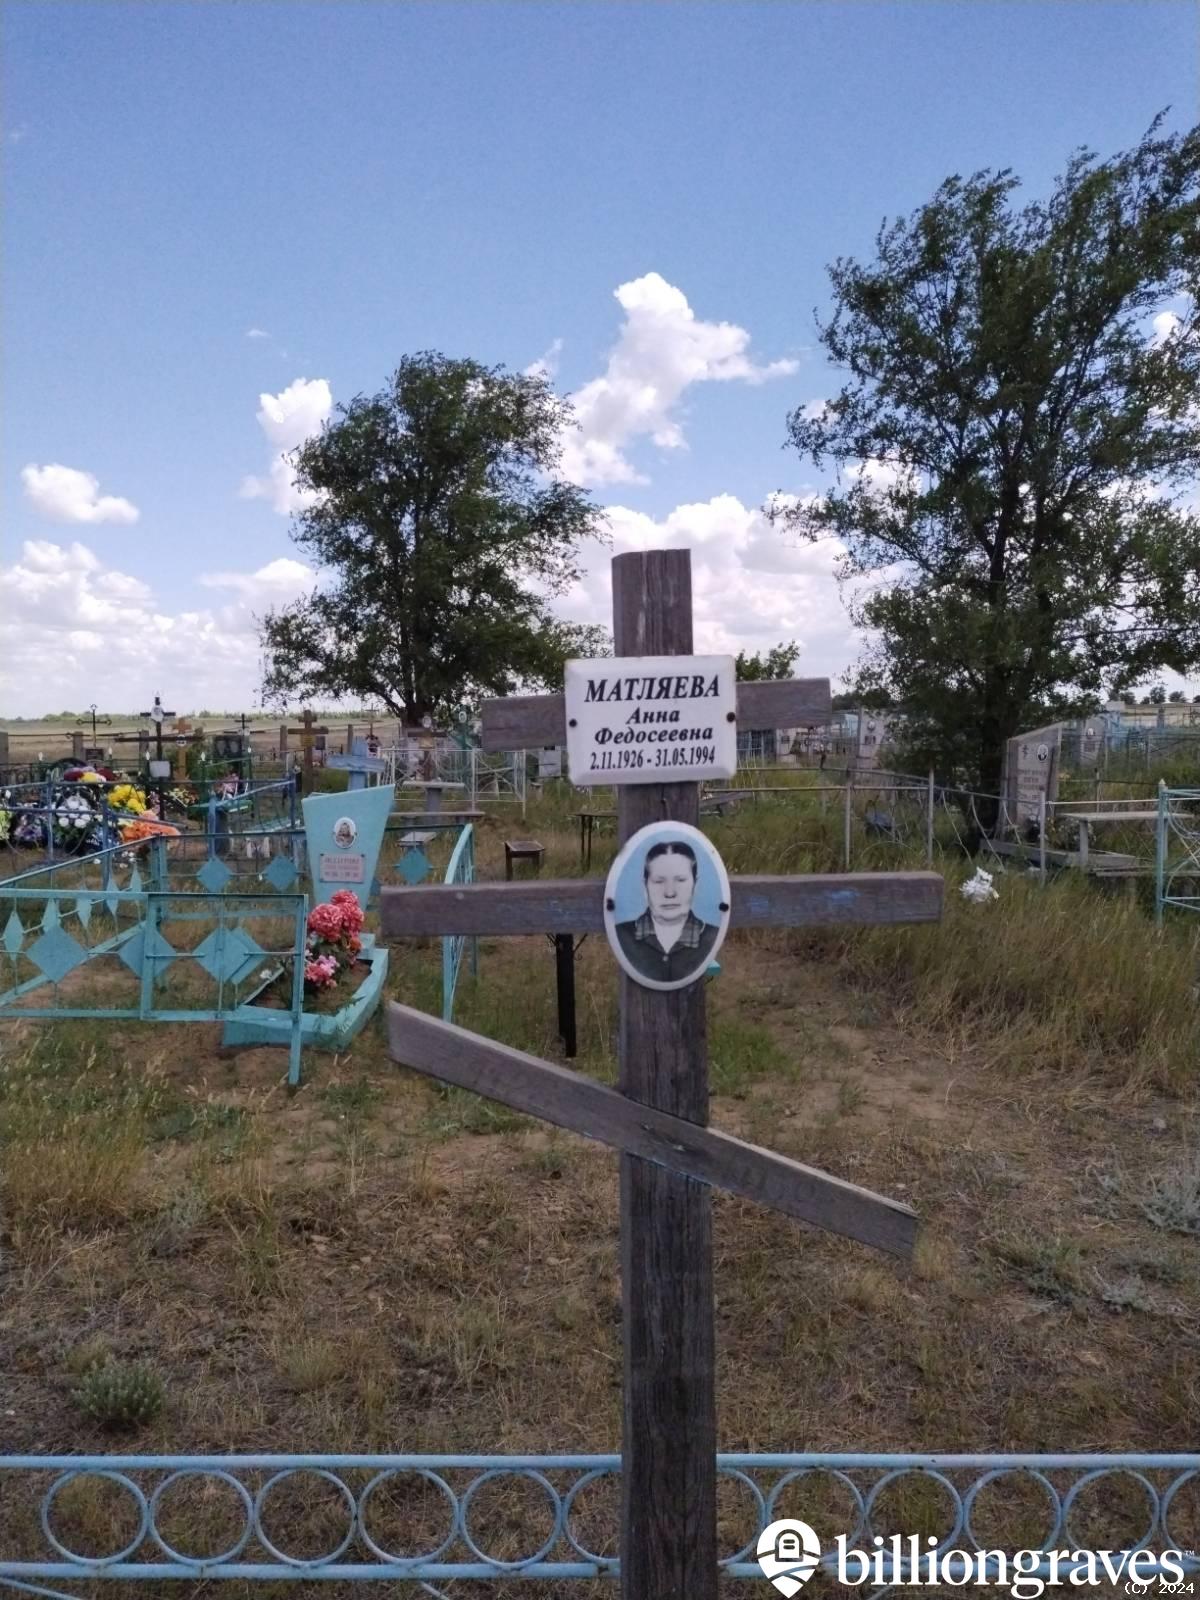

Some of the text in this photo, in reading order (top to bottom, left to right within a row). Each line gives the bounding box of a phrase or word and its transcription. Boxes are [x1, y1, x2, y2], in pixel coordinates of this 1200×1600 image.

[584, 674, 720, 703] МАТЛЯЕВА
[625, 706, 681, 724] Анна
[594, 726, 713, 745] Федосеевна
[590, 749, 644, 770] 2.11.1926
[655, 745, 715, 767] 31.05.1994
